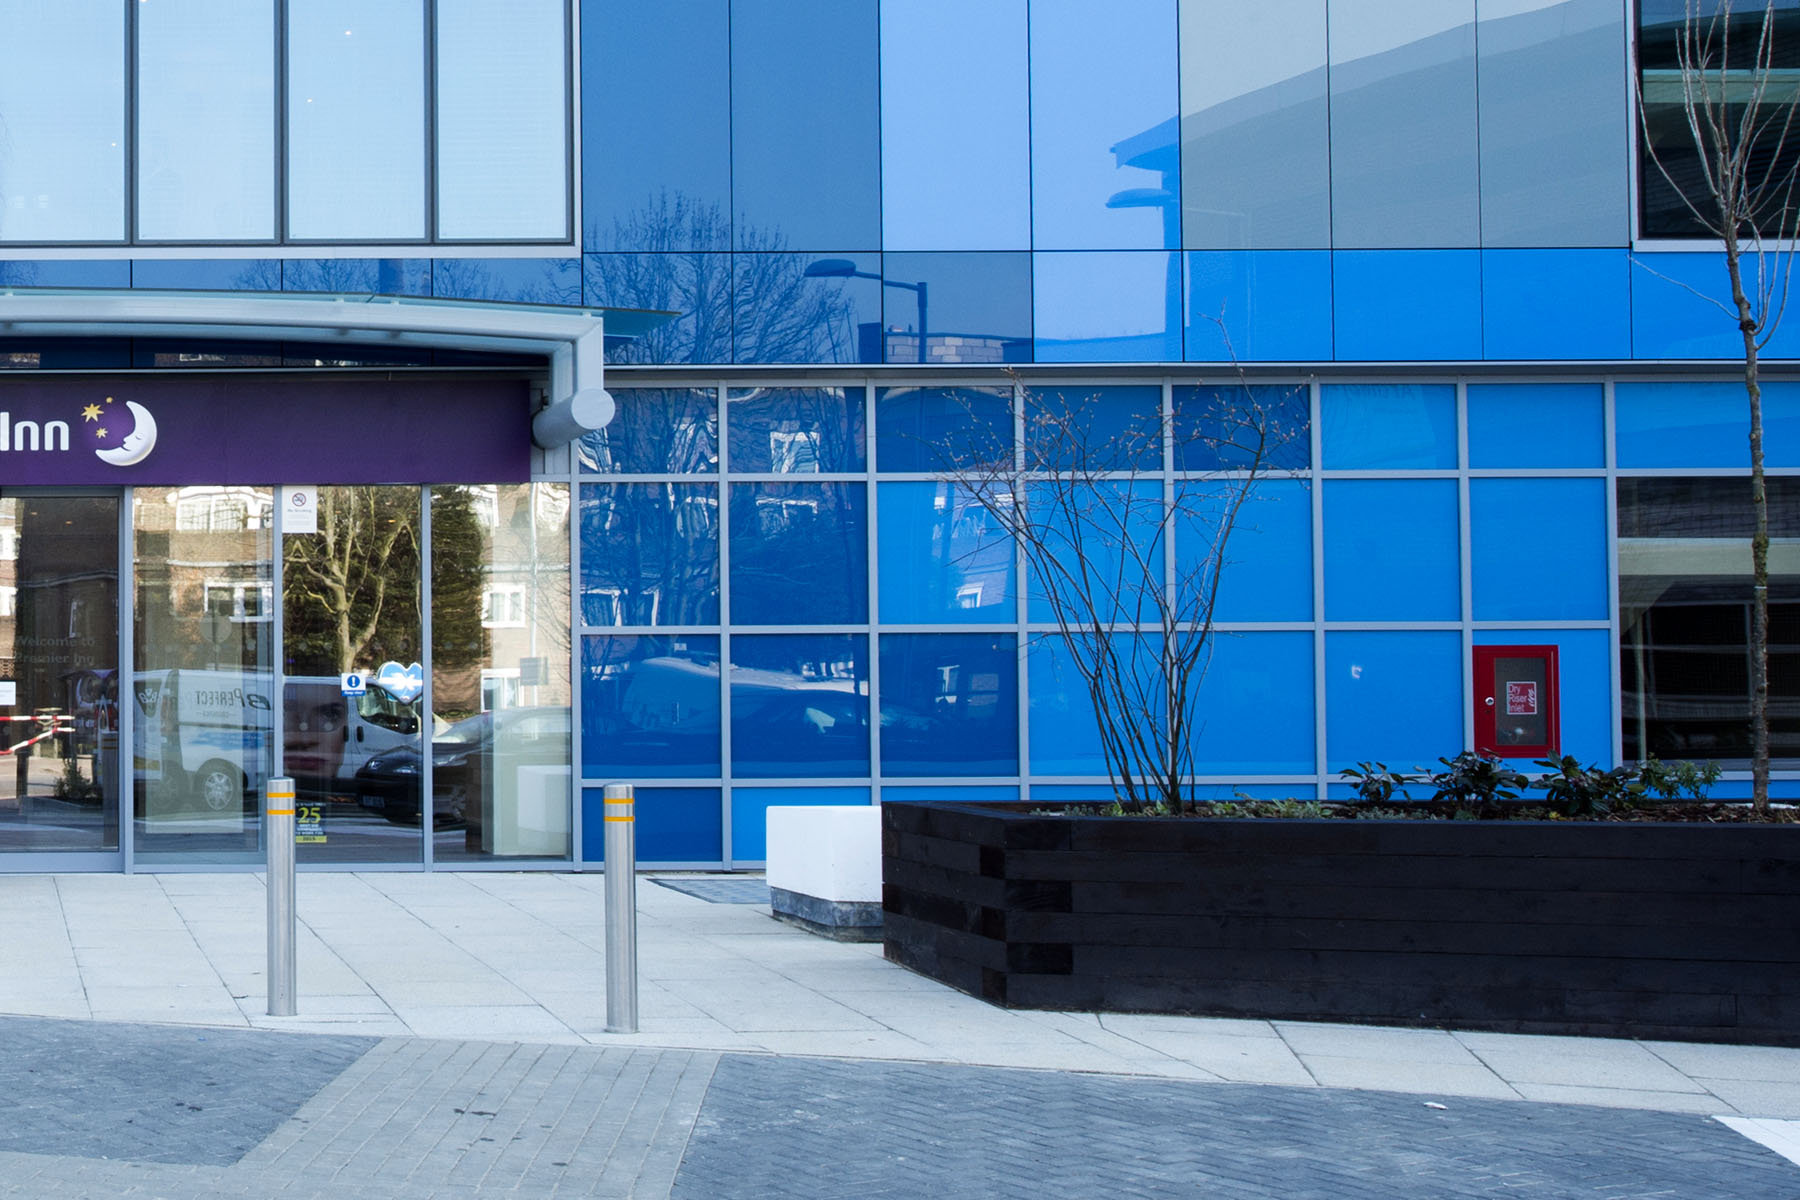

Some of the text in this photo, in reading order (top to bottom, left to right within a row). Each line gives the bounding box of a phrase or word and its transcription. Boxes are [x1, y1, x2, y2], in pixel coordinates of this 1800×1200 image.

[0, 411, 70, 452] Inn
[16, 634, 96, 647] Welcome to
[1509, 684, 1521, 696] Dry
[1509, 694, 1528, 703] Riser
[298, 807, 321, 824] 25
